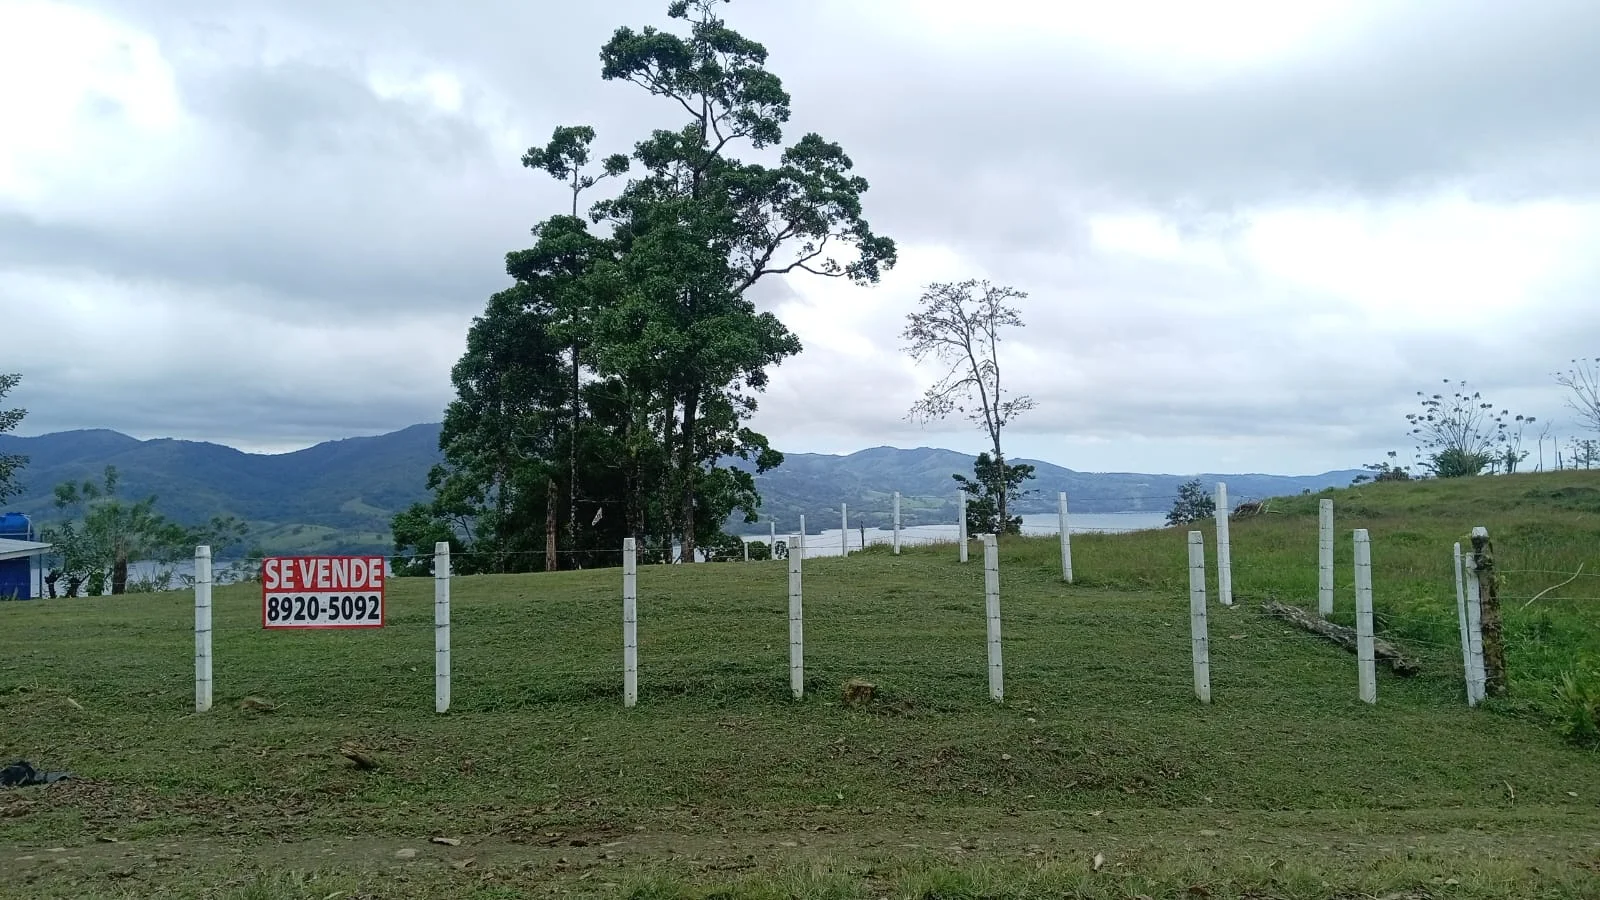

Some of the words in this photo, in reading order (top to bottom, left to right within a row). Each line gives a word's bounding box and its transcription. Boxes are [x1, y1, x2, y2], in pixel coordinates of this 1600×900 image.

[265, 559, 295, 589] SE
[299, 558, 382, 589] VENDE
[267, 595, 380, 621] 8920-5092
